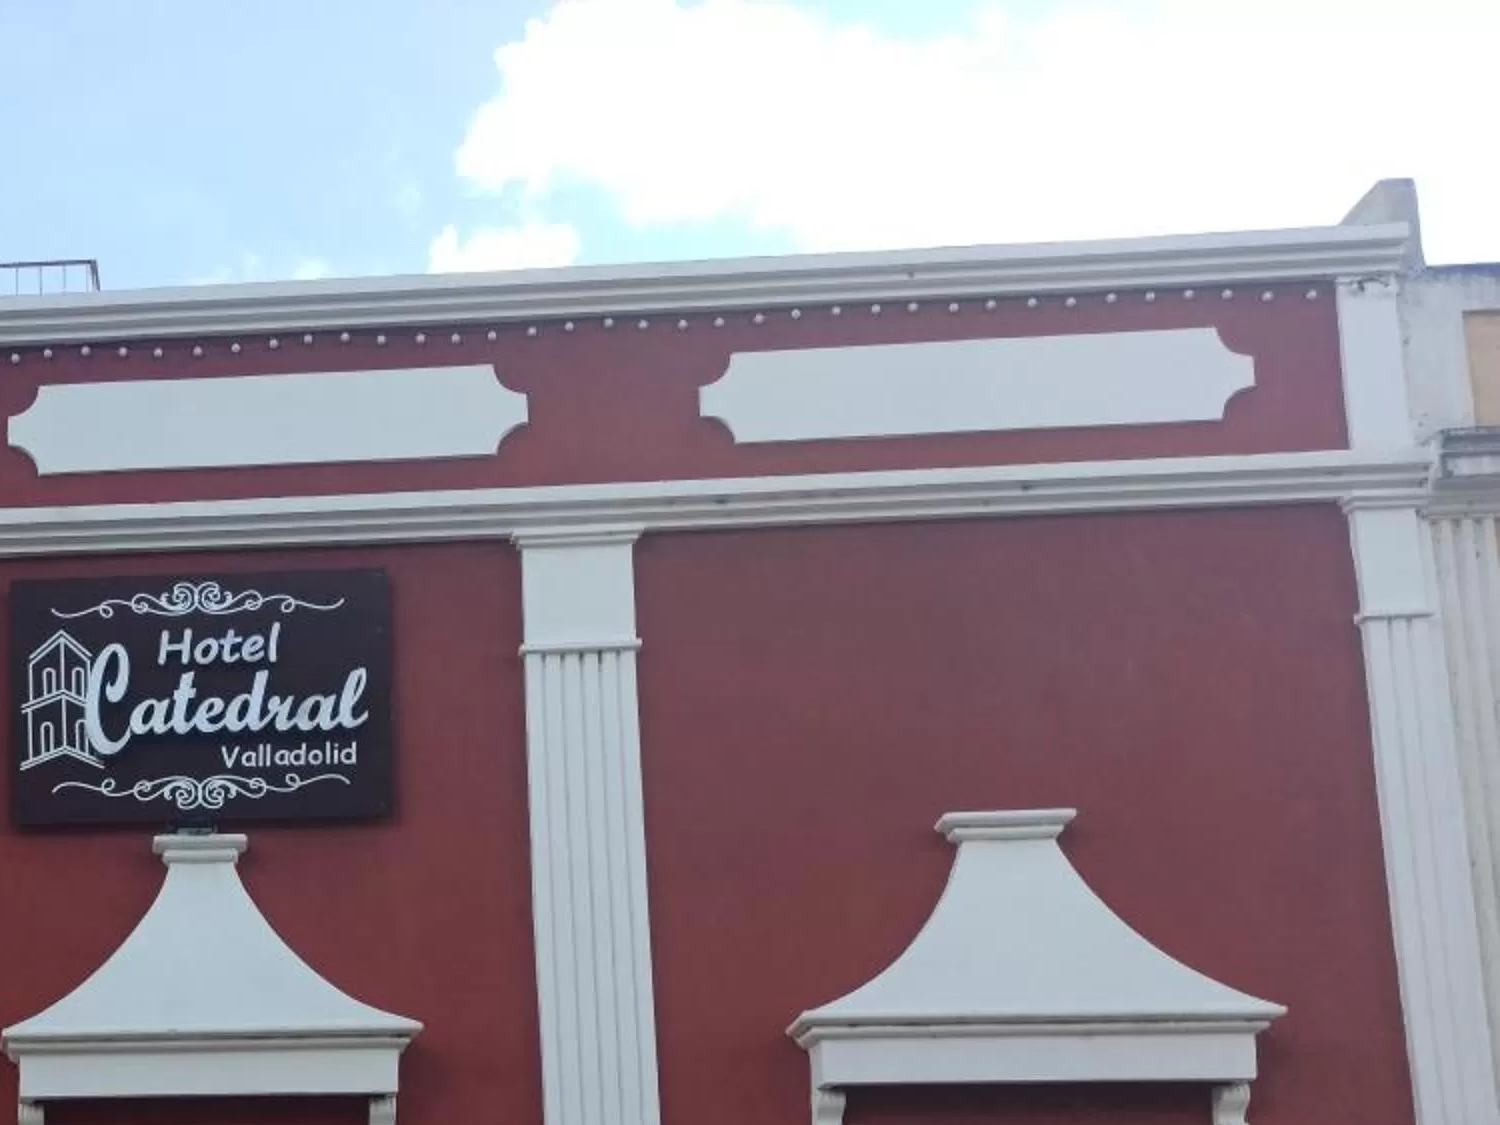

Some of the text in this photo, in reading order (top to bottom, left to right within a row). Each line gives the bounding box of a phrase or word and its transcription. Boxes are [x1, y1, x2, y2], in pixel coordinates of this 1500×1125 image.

[157, 621, 281, 666] Hotel
[84, 642, 369, 755] Catedral
[221, 741, 357, 769] Valladolid
